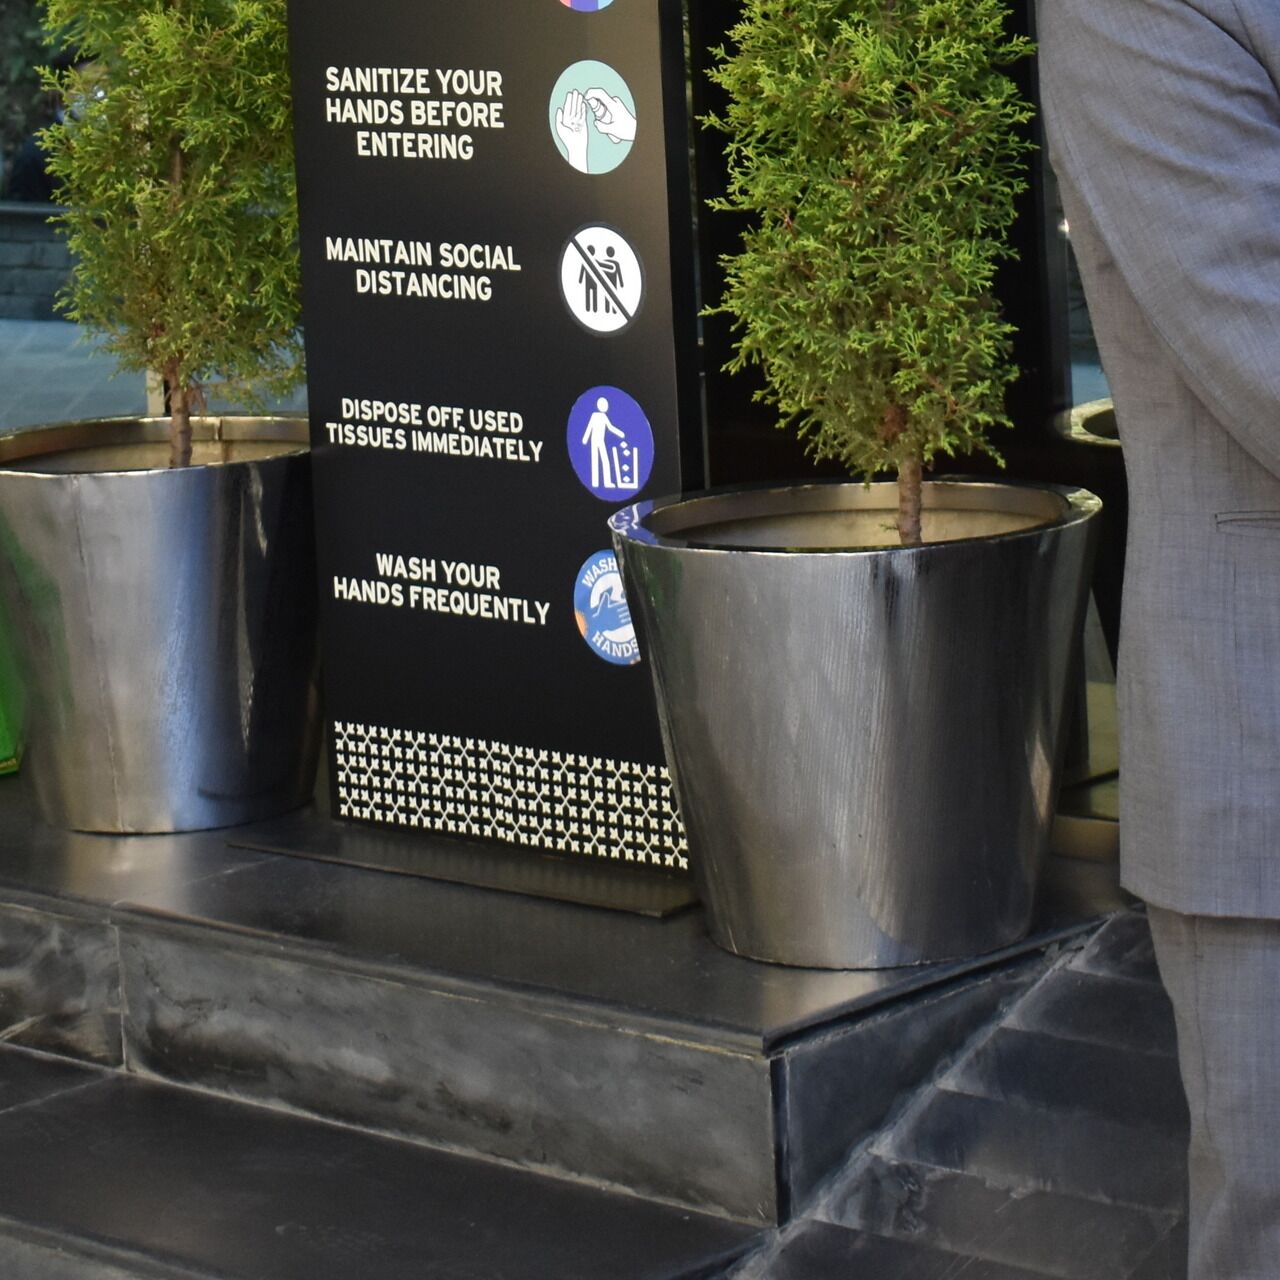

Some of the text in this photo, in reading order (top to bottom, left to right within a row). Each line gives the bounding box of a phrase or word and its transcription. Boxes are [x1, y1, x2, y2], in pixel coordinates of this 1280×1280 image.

[325, 66, 503, 97] SANITIZE YOUR
[326, 97, 505, 129] HANDS BEFORE
[356, 130, 474, 161] ENTERING
[325, 236, 522, 271] MAINTAIN SOCIAL
[356, 268, 492, 301] DISTANCING
[341, 397, 423, 426] DISPOSE
[469, 408, 524, 434] USED
[325, 422, 543, 462] TISSUES IMMEDIATELY
[375, 552, 501, 590] WASH YOUR
[582, 558, 618, 588] WASH
[333, 575, 550, 625] HANDS FREQUENTLY
